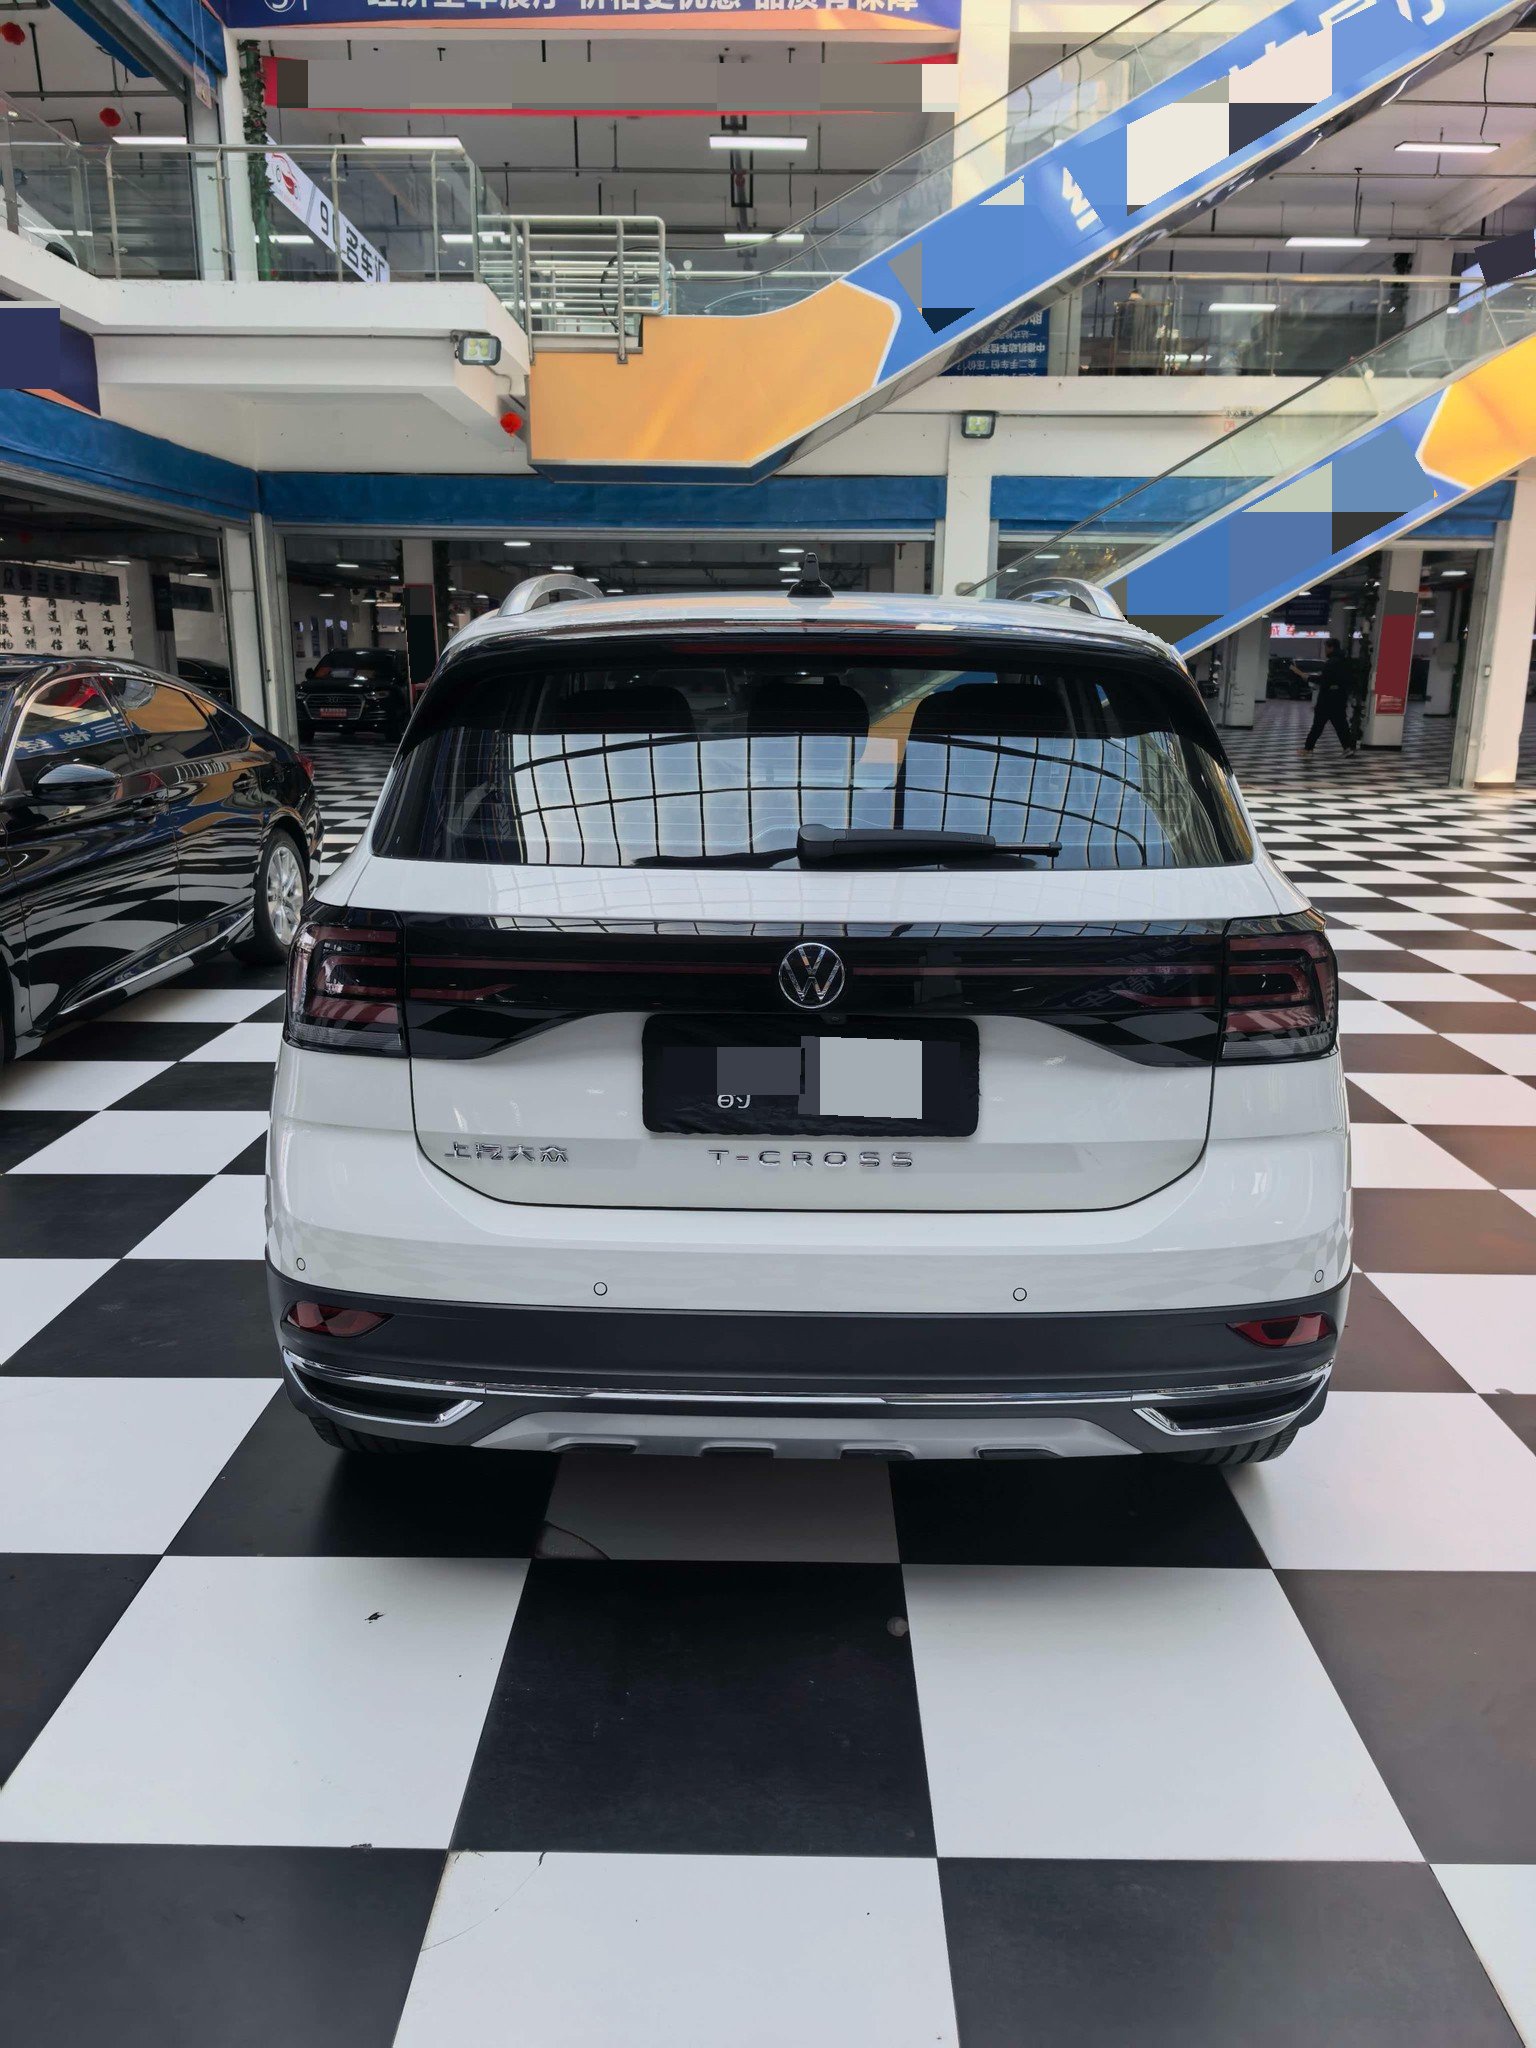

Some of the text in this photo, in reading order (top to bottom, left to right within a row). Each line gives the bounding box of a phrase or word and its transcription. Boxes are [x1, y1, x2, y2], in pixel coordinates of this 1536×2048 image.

[444, 1141, 569, 1163] 上汽大众
[707, 1149, 914, 1168] T-CROSS
